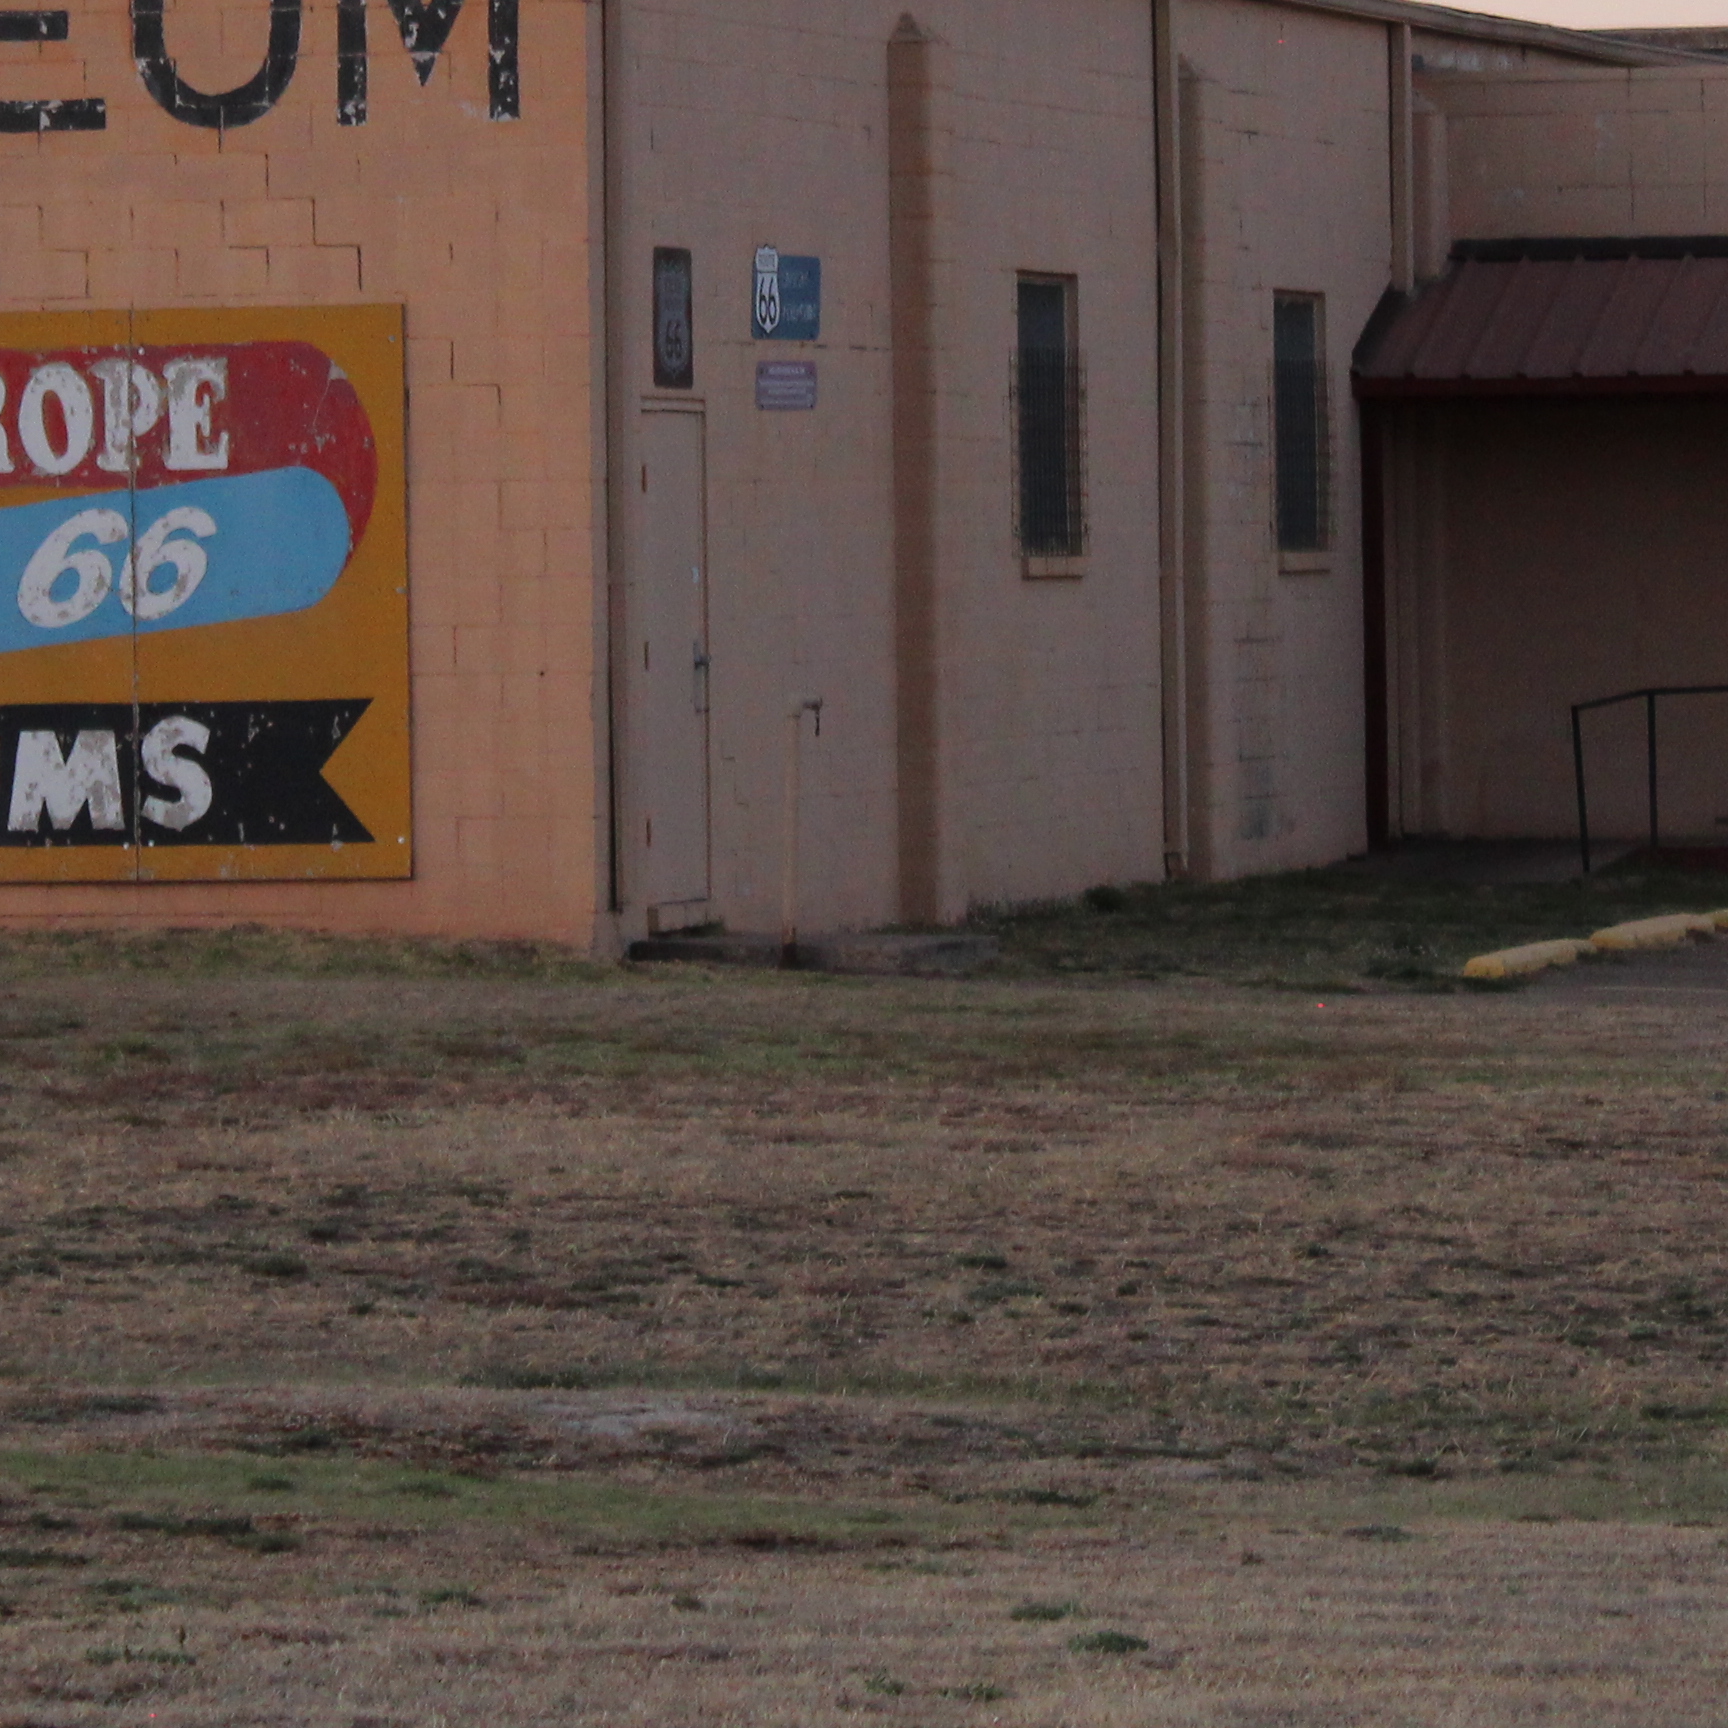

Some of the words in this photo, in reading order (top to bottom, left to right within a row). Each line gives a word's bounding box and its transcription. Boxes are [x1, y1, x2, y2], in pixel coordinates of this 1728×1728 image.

[759, 276, 777, 325] 66
[665, 320, 683, 360] 66
[16, 505, 217, 629] 66
